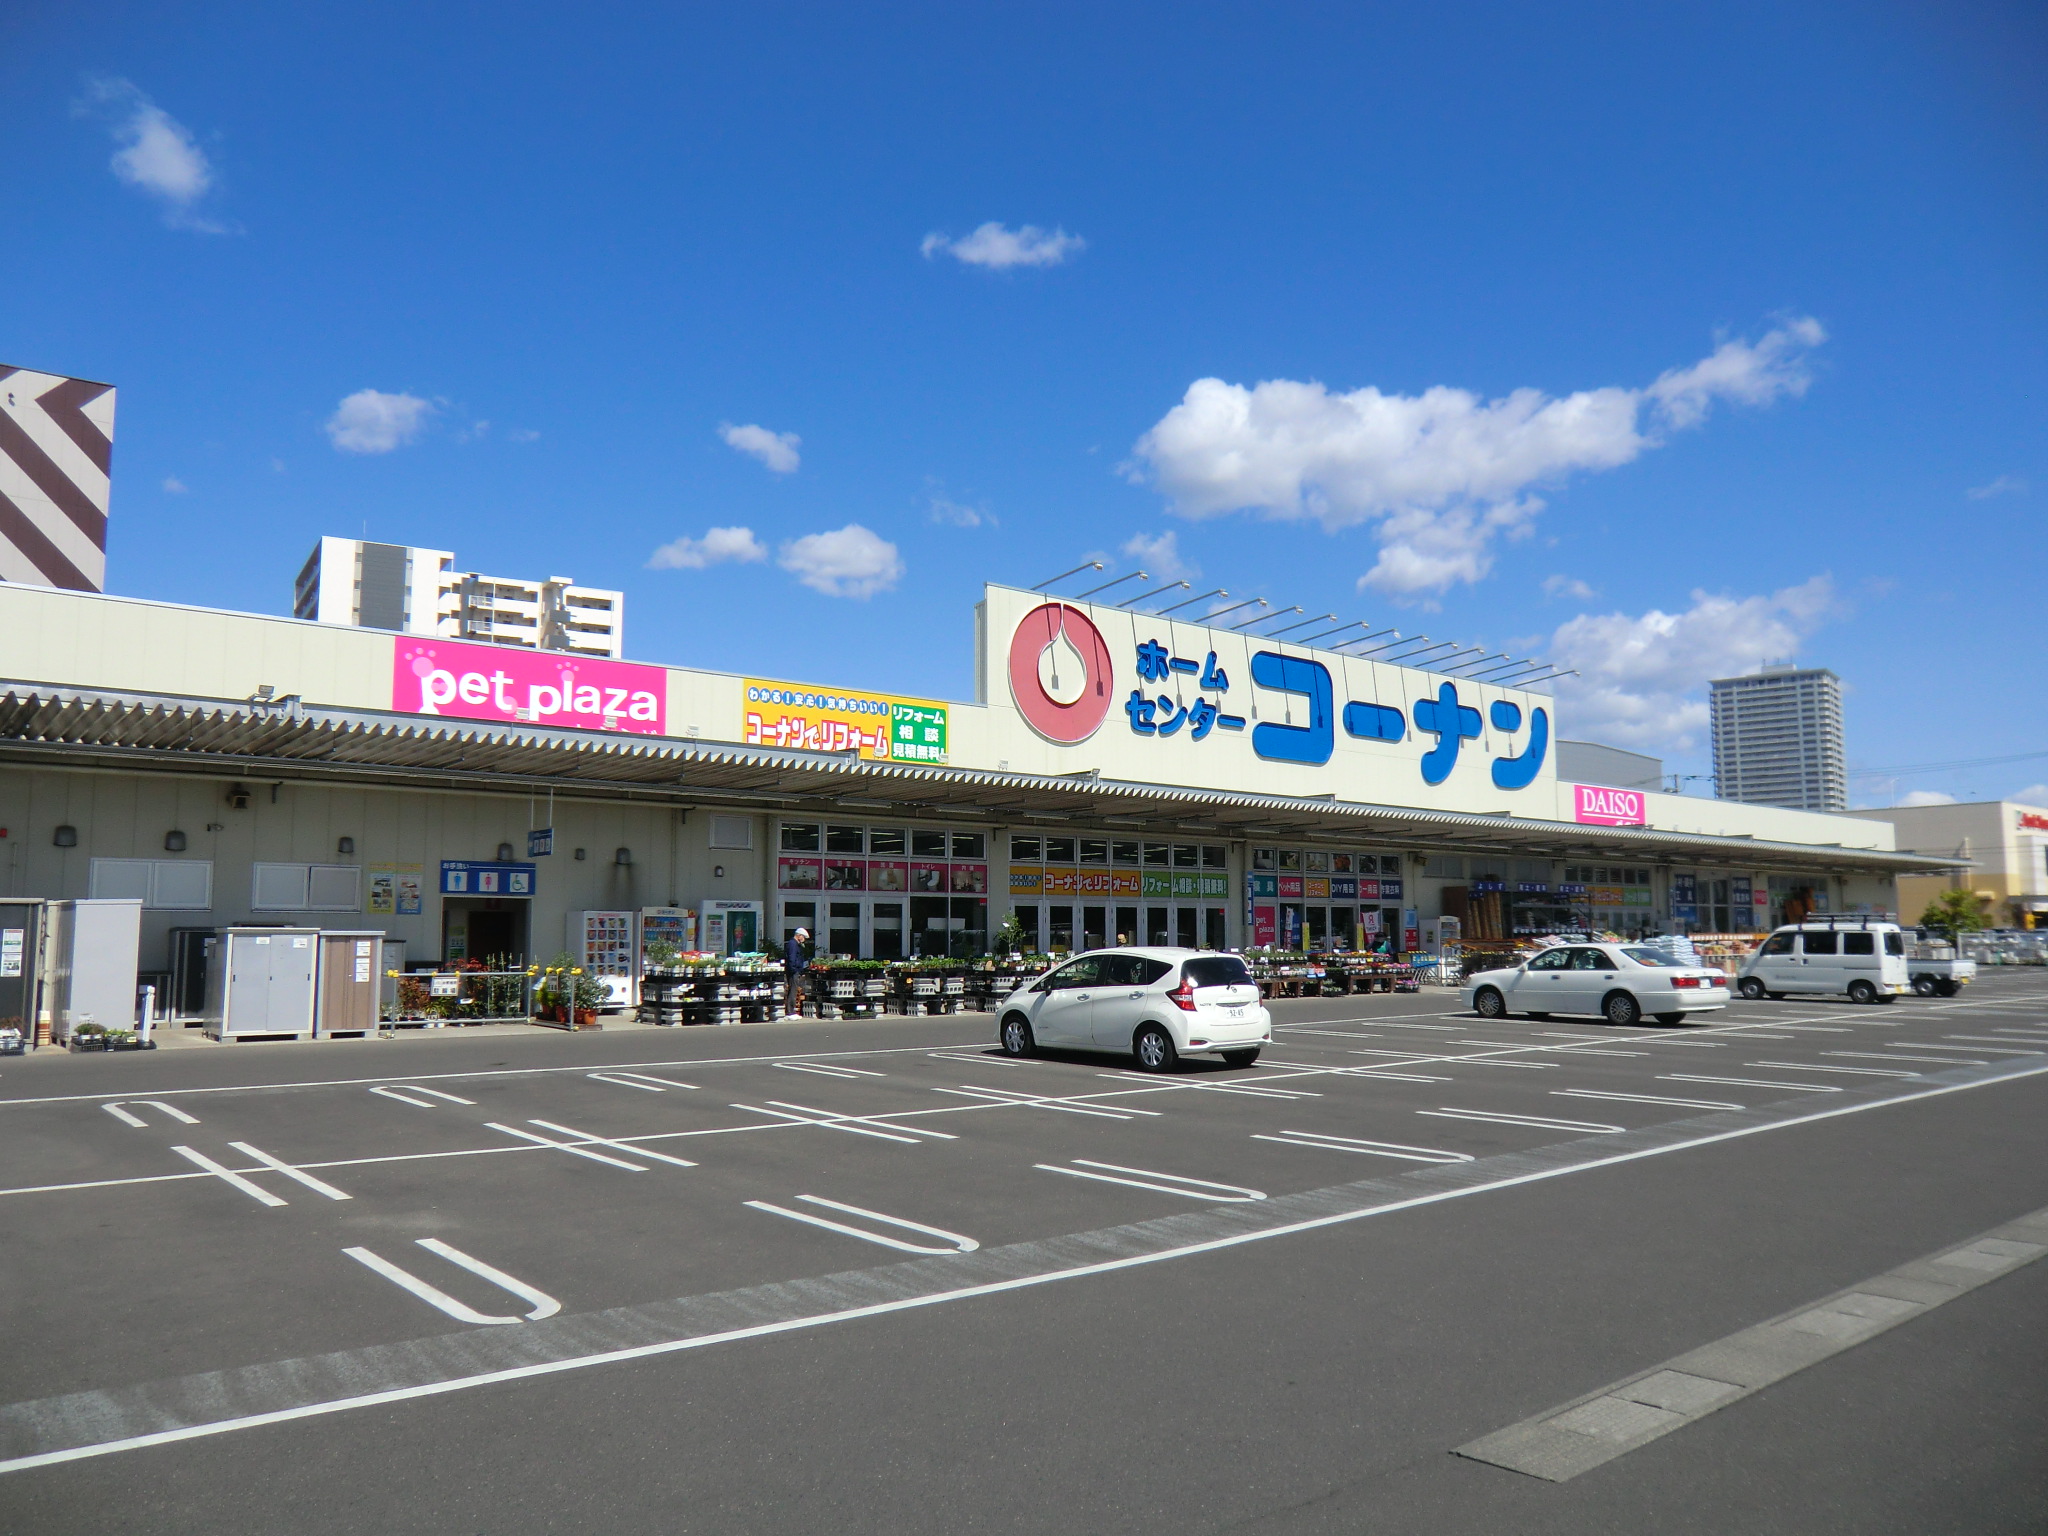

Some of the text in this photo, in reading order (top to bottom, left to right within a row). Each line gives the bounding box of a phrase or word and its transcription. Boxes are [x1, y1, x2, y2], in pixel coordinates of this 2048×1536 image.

[1136, 638, 1231, 692] ホーム
[421, 669, 658, 722] pet plaza
[893, 705, 945, 726] リフォーム
[1125, 690, 1247, 741] センター
[1251, 650, 1550, 790] コーナン
[747, 712, 889, 758] コーナンでリフォーム
[1582, 789, 1638, 816] DAISO
[442, 862, 470, 870] お手洗い
[788, 858, 811, 866] キッチン
[921, 863, 935, 871] トイレ
[1045, 873, 1139, 891] コーナンでリフォーム
[1332, 883, 1355, 894] DIY用品
